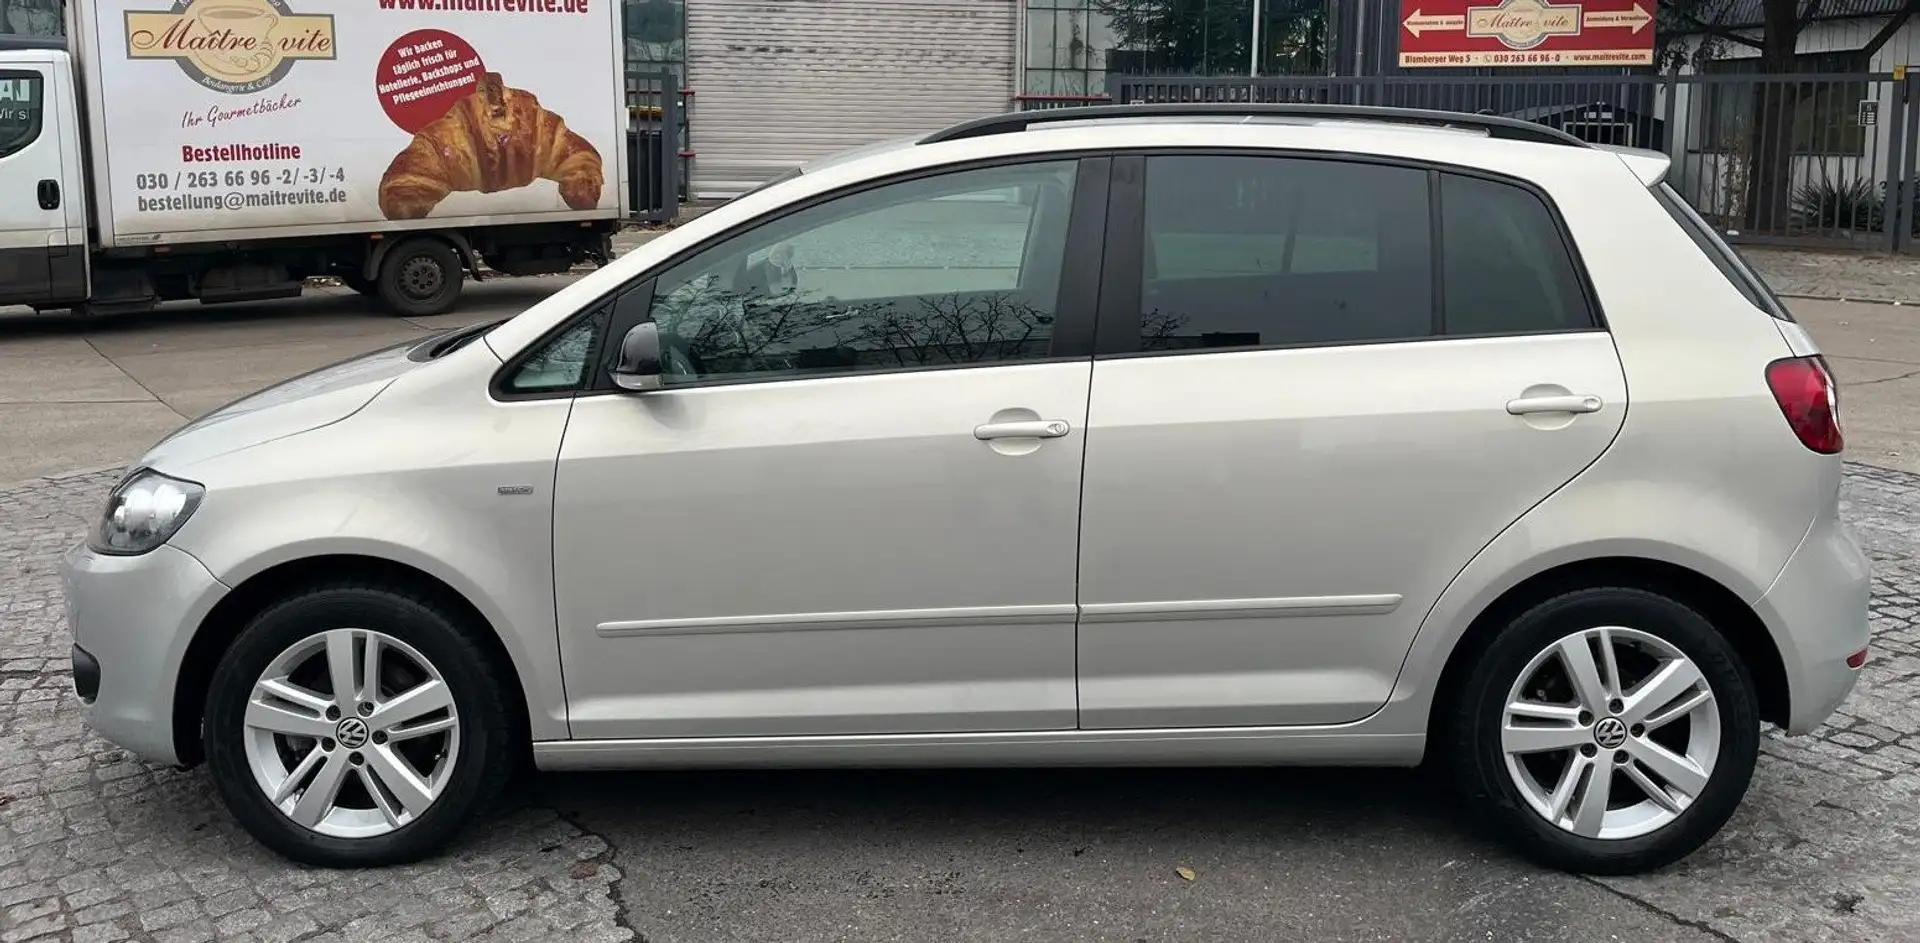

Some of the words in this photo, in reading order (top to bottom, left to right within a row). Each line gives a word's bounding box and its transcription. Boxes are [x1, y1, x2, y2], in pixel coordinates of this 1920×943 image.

[131, 18, 256, 50] Maître
[277, 28, 331, 52] vite
[398, 47, 413, 58] Wir
[414, 39, 443, 54] backen
[1405, 54, 1447, 64] Blomberger
[1448, 55, 1464, 64] Weg
[1494, 54, 1508, 63] 030
[1511, 54, 1525, 63] 263
[1528, 54, 1538, 62] 66
[392, 60, 420, 76] täglich
[421, 53, 444, 67] frisch
[445, 49, 457, 60] für
[421, 63, 463, 82] Backshops
[463, 56, 480, 69] und
[181, 111, 202, 128] Ihr
[207, 92, 302, 127] Gourmetbäcker
[182, 143, 301, 162] Bestellhotline
[136, 173, 168, 190] 030
[187, 172, 218, 188] 263
[224, 170, 245, 186] 66
[251, 169, 270, 185] 96
[329, 167, 345, 182] -4
[138, 188, 347, 212] bestellung@maitrevite.de
